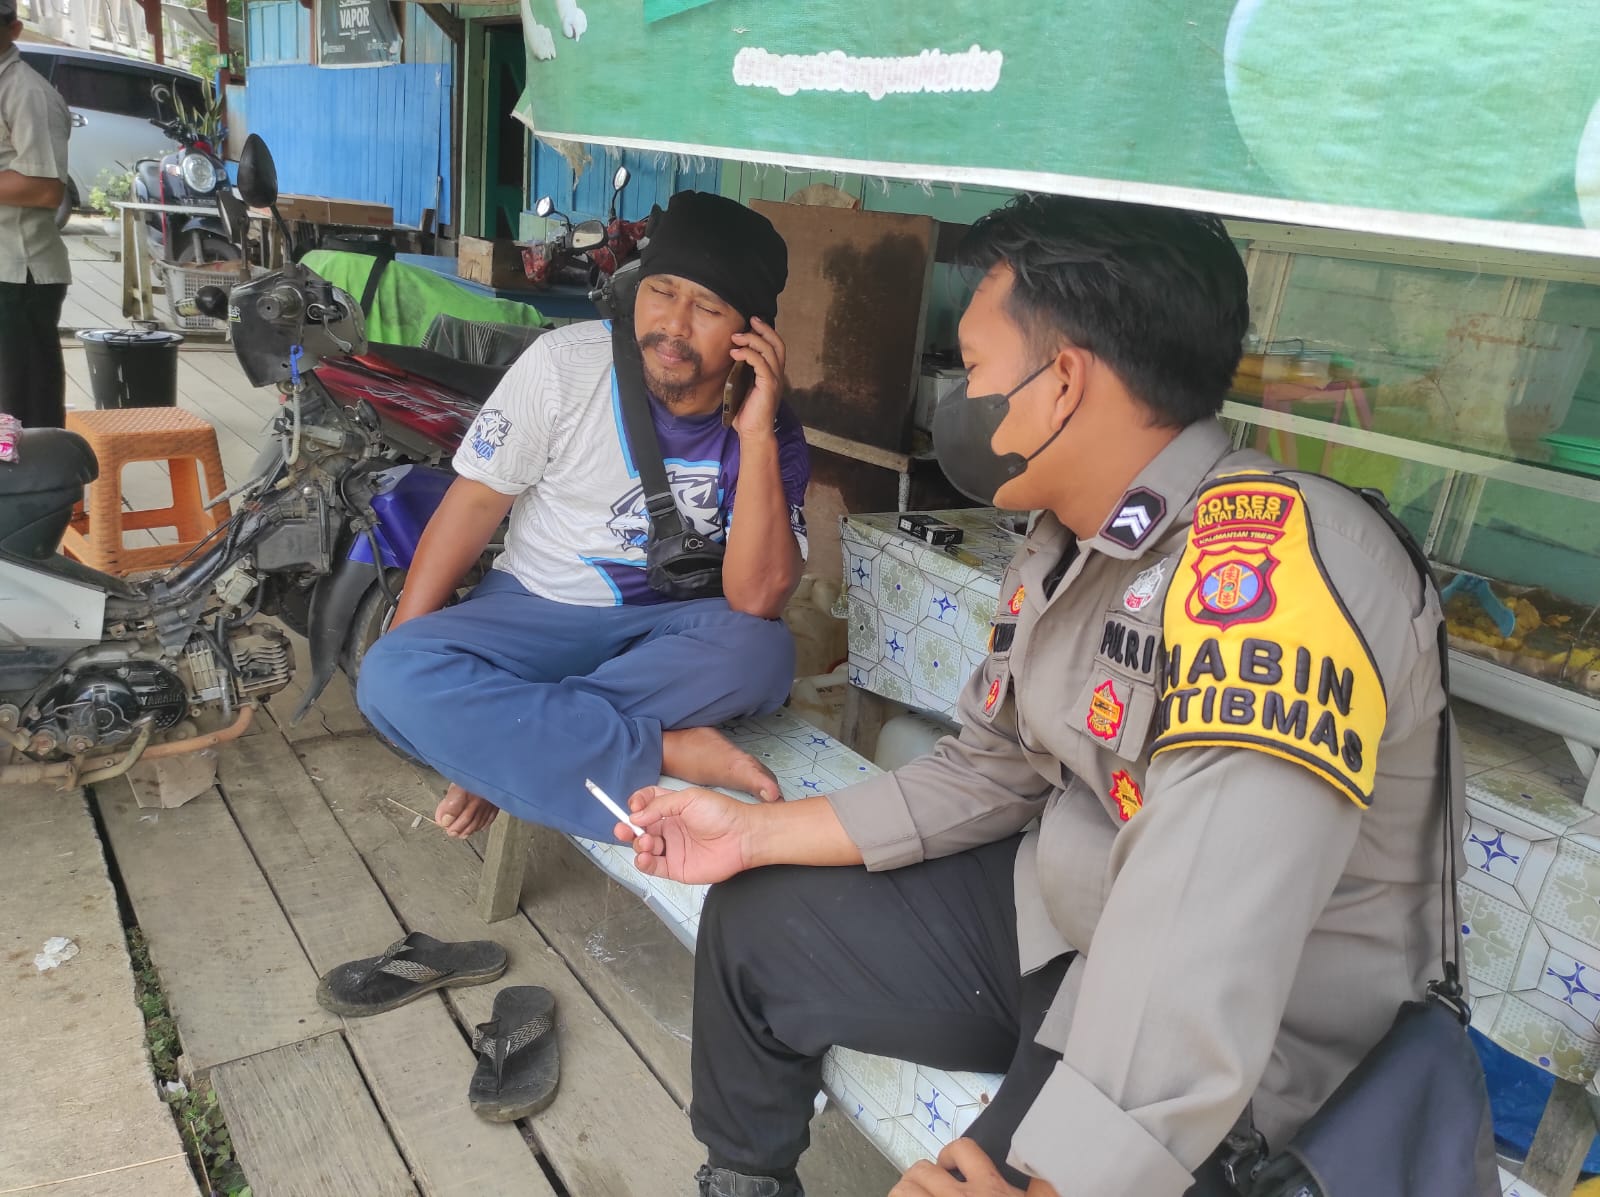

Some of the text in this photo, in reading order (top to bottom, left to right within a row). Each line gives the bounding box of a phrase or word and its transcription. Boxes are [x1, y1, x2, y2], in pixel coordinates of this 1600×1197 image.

[340, 7, 370, 29] VAPOR
[473, 439, 495, 461] EVOS
[1198, 494, 1281, 515] POLRES
[1198, 508, 1280, 528] KUTAI BARAT
[141, 694, 181, 706] YAMAHA
